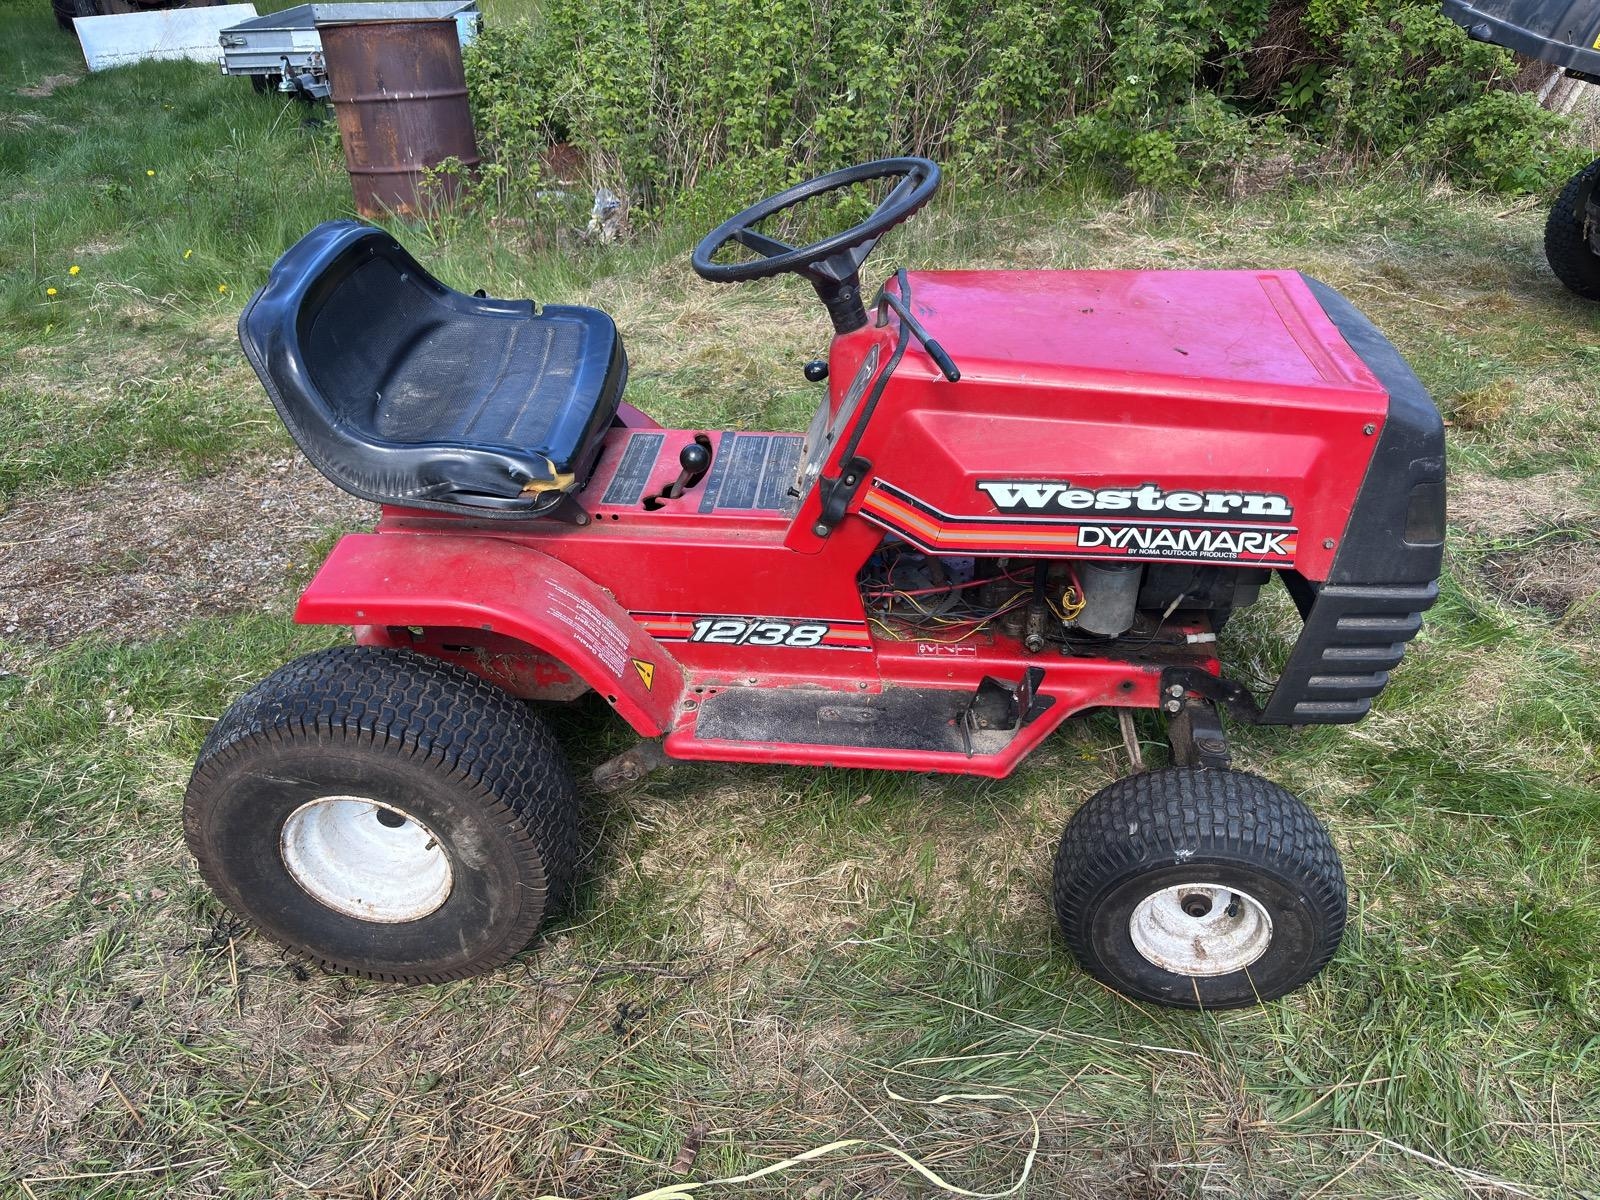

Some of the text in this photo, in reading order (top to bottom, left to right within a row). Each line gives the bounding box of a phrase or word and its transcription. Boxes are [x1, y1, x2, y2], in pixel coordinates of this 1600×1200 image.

[978, 483, 1291, 516] Western
[1077, 526, 1289, 555] DYNAMARK
[1199, 551, 1238, 559] PRODUCTS
[691, 619, 829, 647] 12/38
